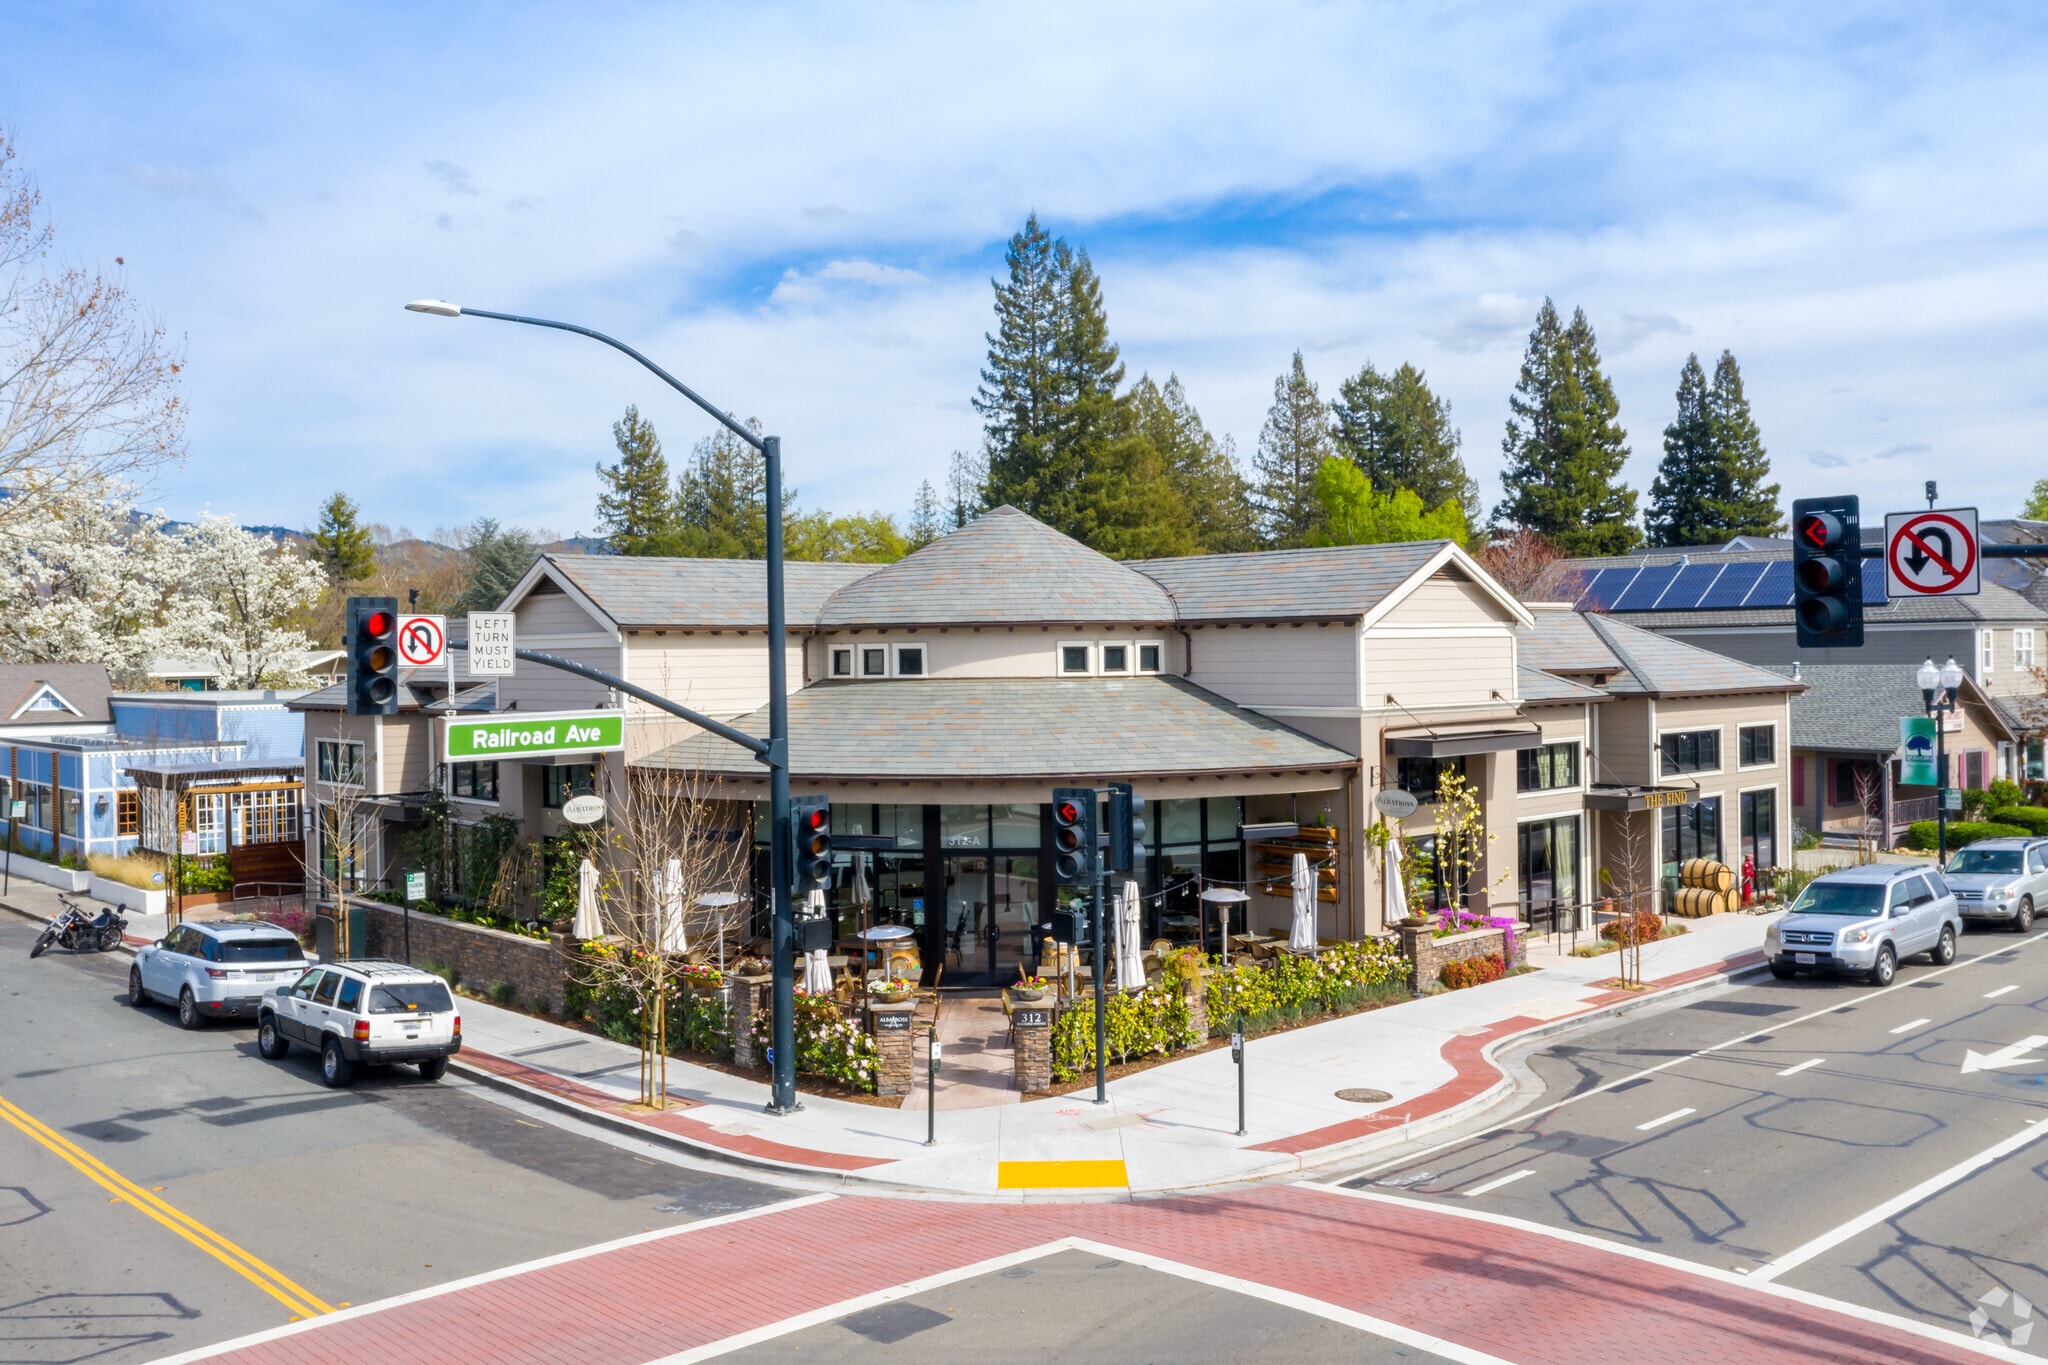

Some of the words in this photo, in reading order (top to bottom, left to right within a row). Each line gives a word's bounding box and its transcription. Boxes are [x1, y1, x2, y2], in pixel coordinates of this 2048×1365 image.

[475, 619, 508, 629] LEFT
[475, 632, 509, 642] TURN
[475, 646, 508, 655] MUST
[474, 659, 511, 668] YIELD
[473, 726, 555, 749] Railroad
[565, 724, 601, 743] Ave
[1644, 793, 1663, 808] THE
[1666, 791, 1687, 807] FIND
[948, 836, 980, 846] 312-A
[1021, 1013, 1041, 1023] 312
